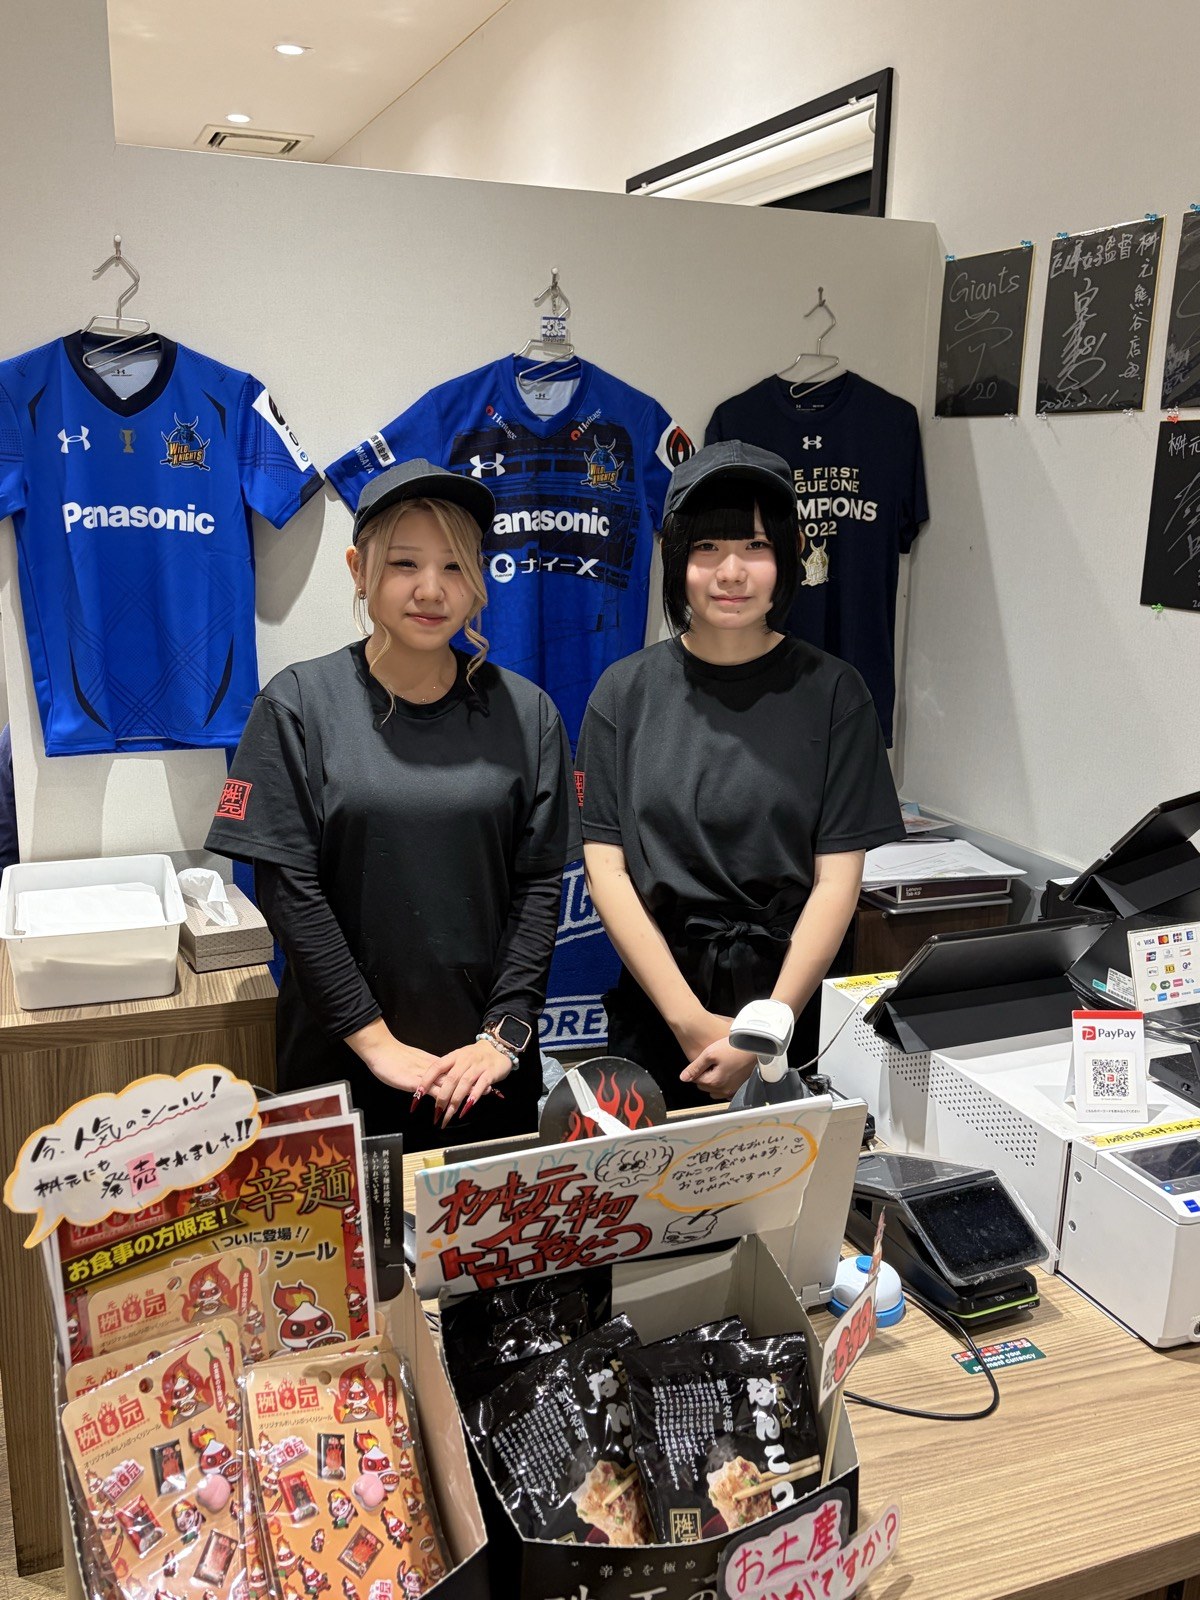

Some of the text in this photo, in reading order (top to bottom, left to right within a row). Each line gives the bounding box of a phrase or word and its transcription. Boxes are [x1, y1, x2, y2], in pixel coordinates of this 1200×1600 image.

[950, 266, 1020, 302] Giants
[972, 382, 997, 401] 20
[492, 412, 517, 440] Heritage
[578, 408, 602, 434] Heritage
[172, 450, 203, 466] KNIGHTS
[355, 445, 375, 475] MAGAYA
[795, 479, 860, 494] GUE ONE
[813, 467, 859, 480] FIRST
[62, 501, 215, 535] Panasonic
[797, 496, 878, 522] MPIONS
[493, 507, 610, 538] anasonic
[803, 521, 838, 538] 022
[1144, 938, 1155, 946] VISA
[538, 1007, 609, 1037] DRE
[1098, 1024, 1136, 1040] PayPay
[243, 1160, 353, 1222] 辛麺
[273, 1242, 337, 1269] シール
[973, 1353, 1036, 1372] pament currency
[981, 1350, 1021, 1363] hoose your
[746, 1378, 795, 1511] なんこつ
[735, 1504, 839, 1594] お土産
